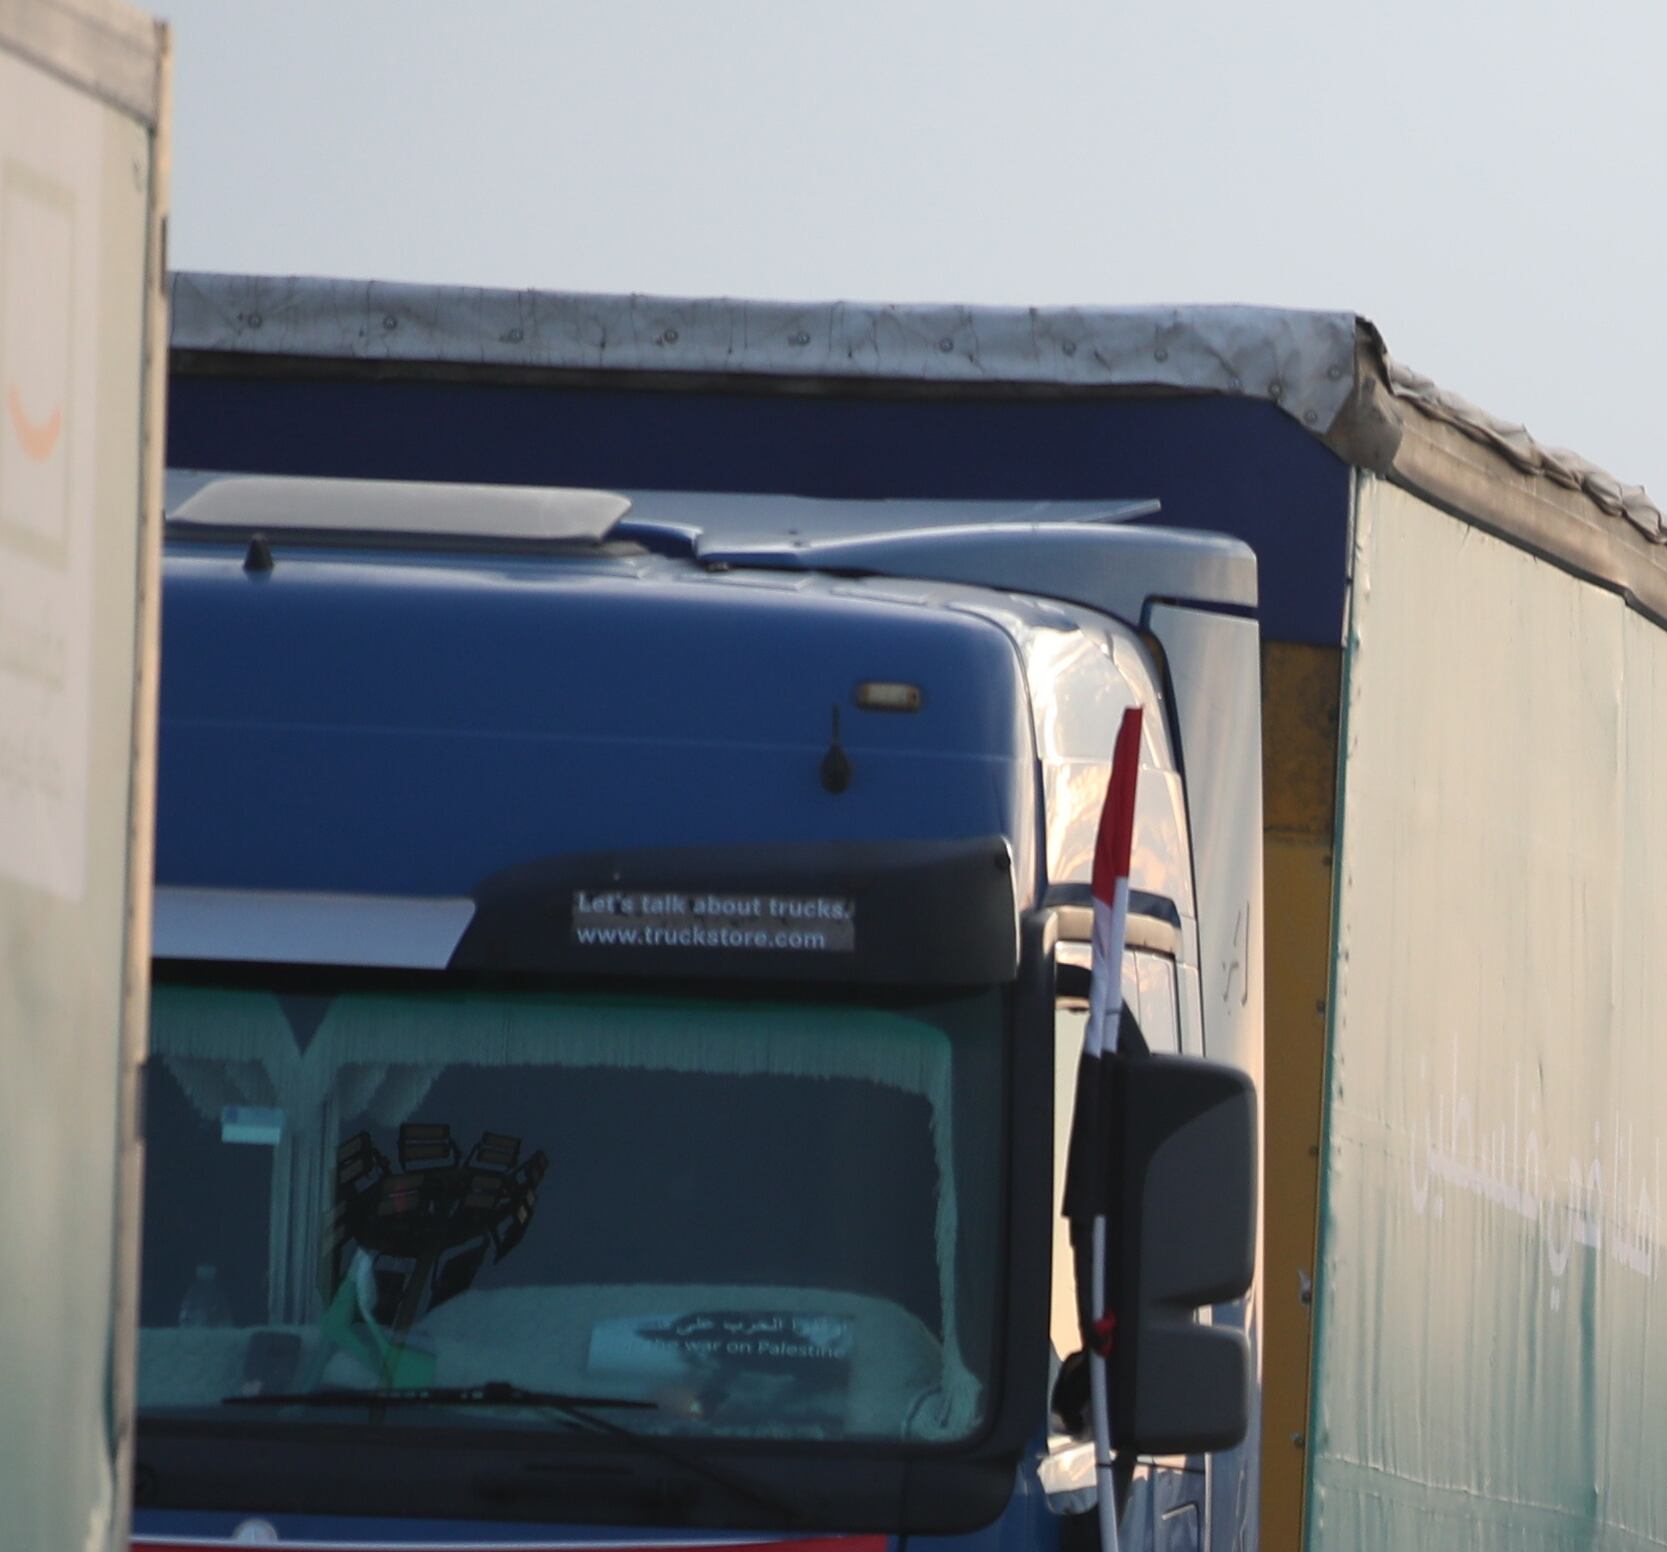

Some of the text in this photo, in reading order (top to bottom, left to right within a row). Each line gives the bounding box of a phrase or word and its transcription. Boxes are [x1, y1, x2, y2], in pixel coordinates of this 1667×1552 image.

[579, 892, 850, 920] Let's talk about trucks.
[576, 923, 826, 948] www.truckstore.com
[726, 1340, 753, 1354] on
[757, 1338, 847, 1360] Palestine
